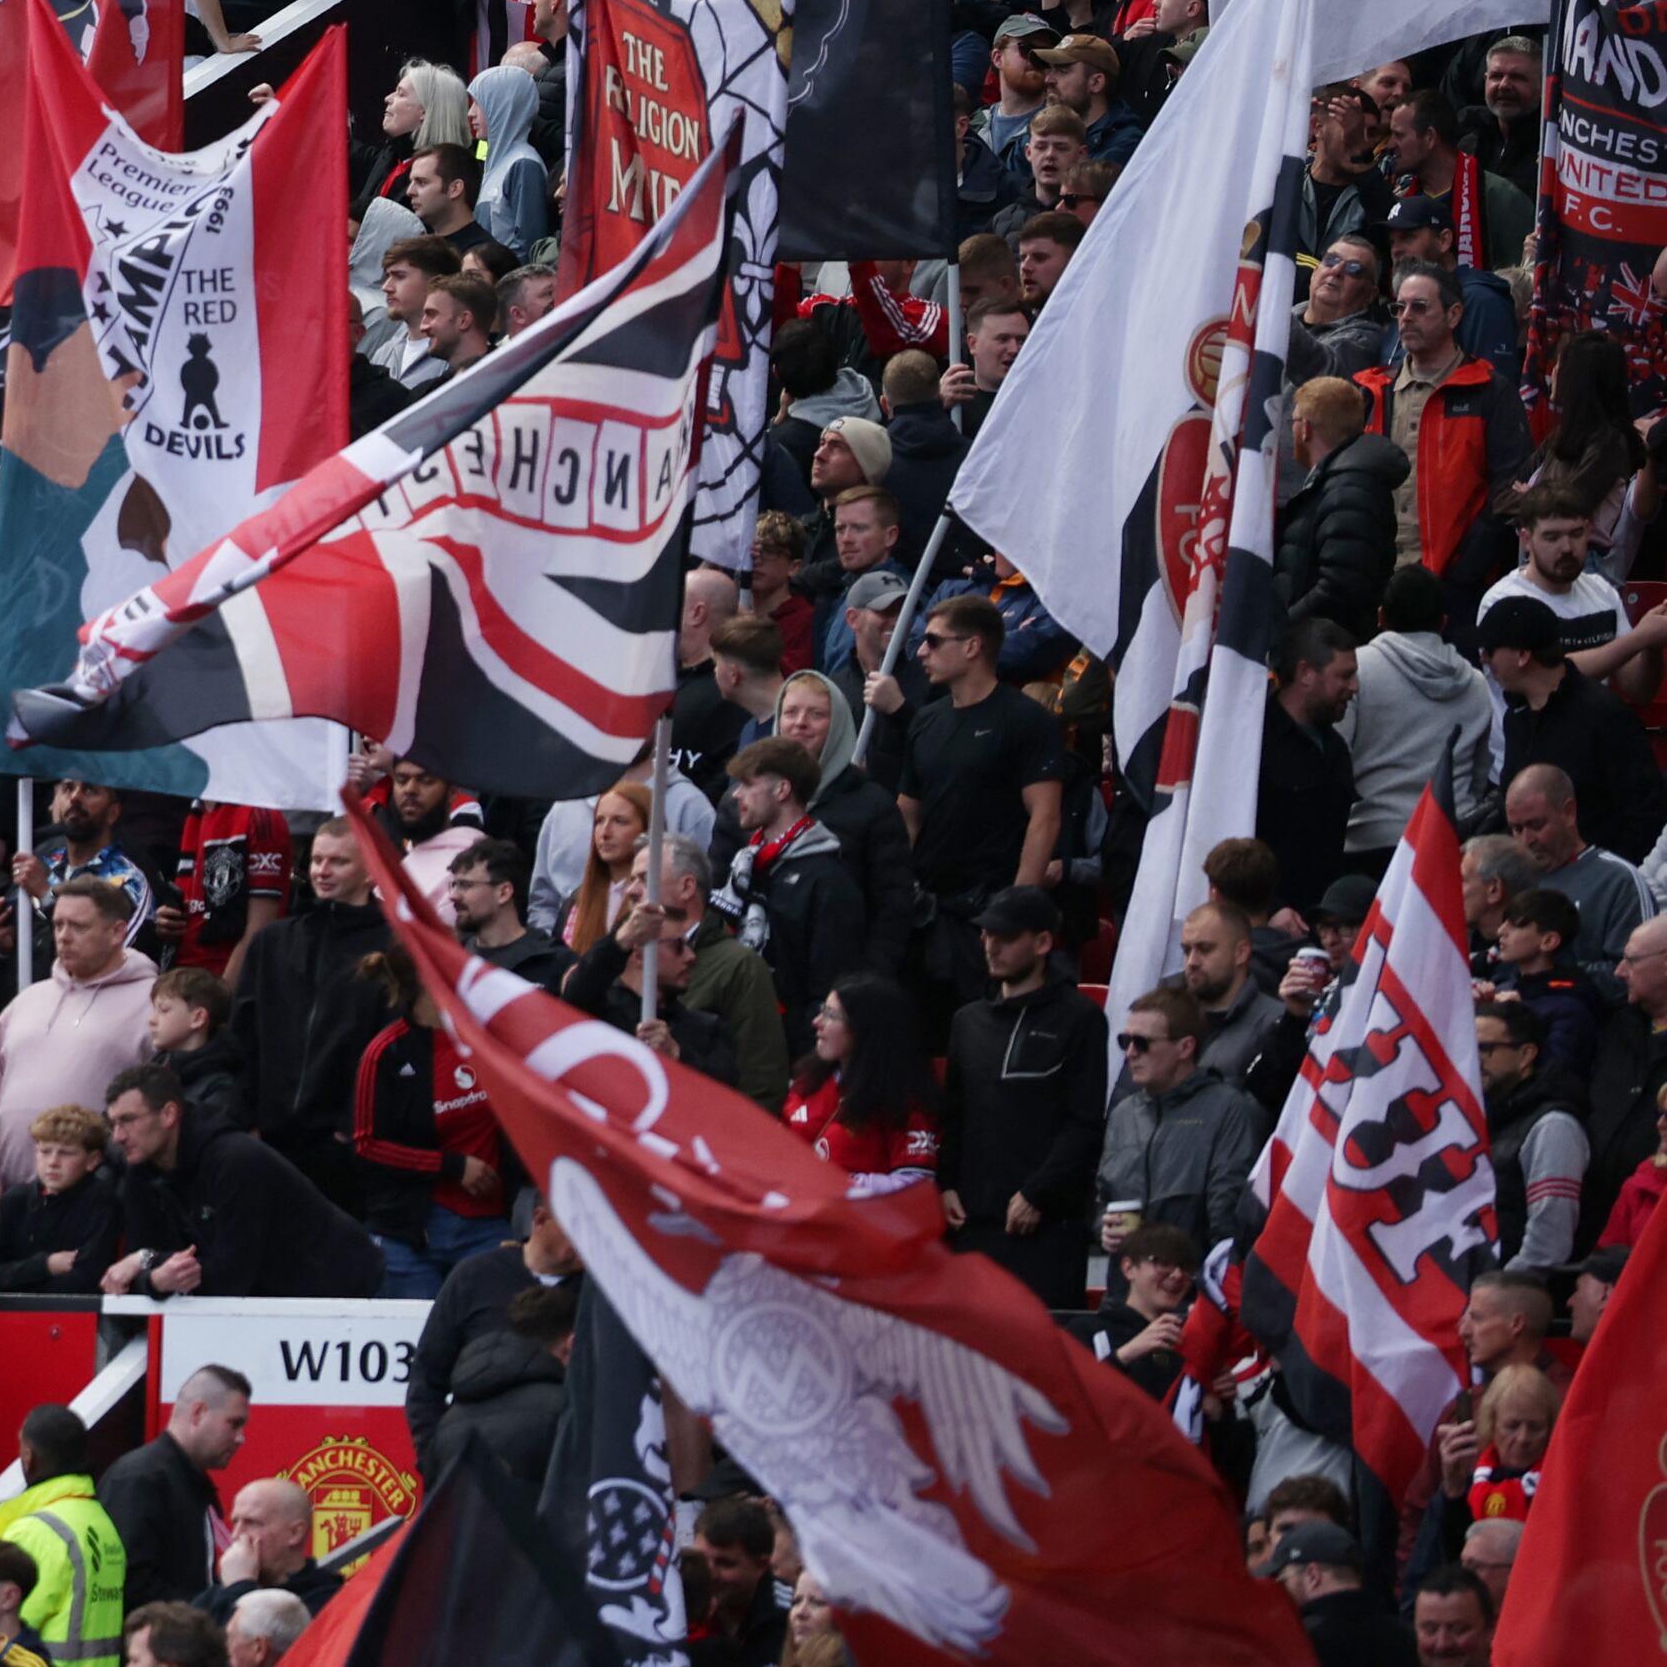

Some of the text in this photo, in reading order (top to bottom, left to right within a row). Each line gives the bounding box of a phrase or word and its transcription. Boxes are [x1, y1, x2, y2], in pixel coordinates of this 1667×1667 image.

[624, 29, 669, 92] THE
[605, 64, 701, 163] RLIGION
[85, 159, 176, 216] League
[98, 140, 198, 198] Premier
[203, 186, 235, 236] 1993
[1564, 194, 1623, 233] F.C.
[182, 267, 236, 295] THE
[184, 299, 237, 326] RED
[145, 422, 246, 461] DEVILS
[432, 1090, 488, 1114] Snapdra
[279, 1340, 413, 1384] W103
[296, 1447, 405, 1508] ANCHESTER
